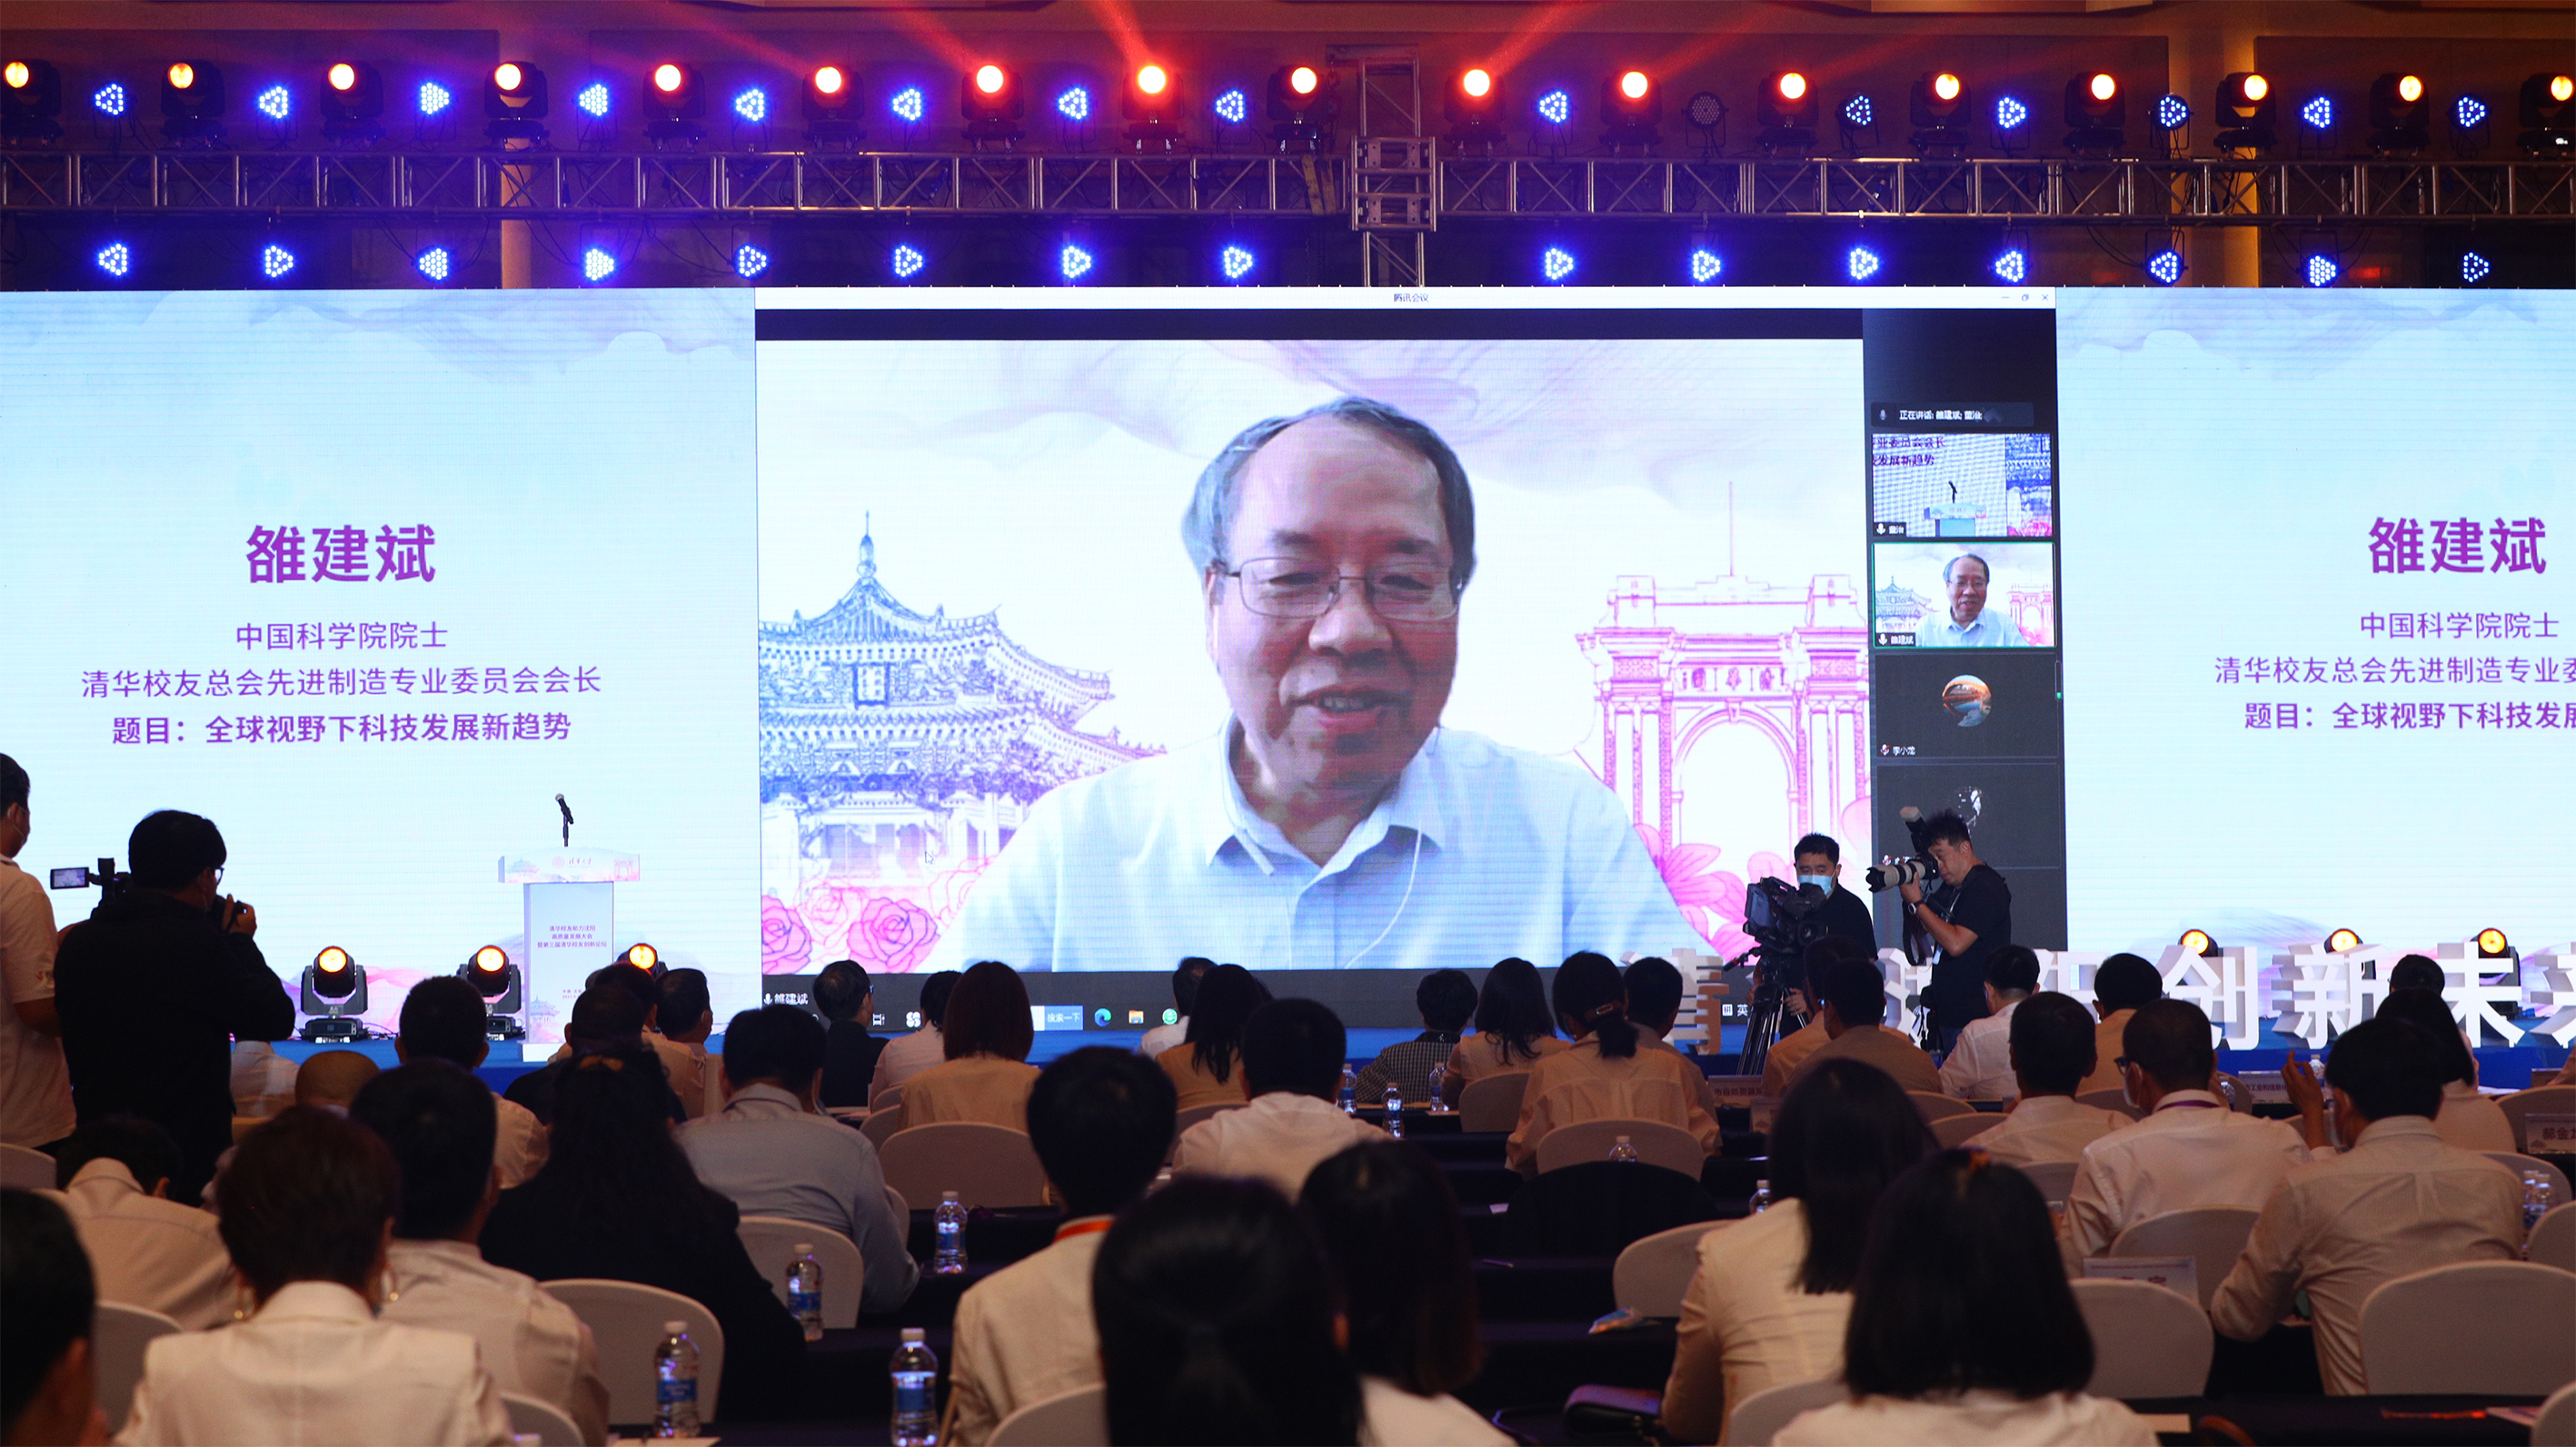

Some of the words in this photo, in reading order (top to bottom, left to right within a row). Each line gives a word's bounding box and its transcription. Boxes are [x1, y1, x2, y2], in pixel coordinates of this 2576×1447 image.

[1393, 292, 1429, 302] 腾讯会议
[246, 524, 436, 583] 雒建斌
[2368, 517, 2547, 574] 雒建斌
[236, 622, 448, 650] 中国科学院院士
[2361, 612, 2559, 639] 中国科学院院士
[82, 666, 601, 698] 清华校友总会先进制造专业委员会会长
[1047, 1013, 1080, 1023] 搜索一下
[1736, 1004, 1748, 1016] 英
